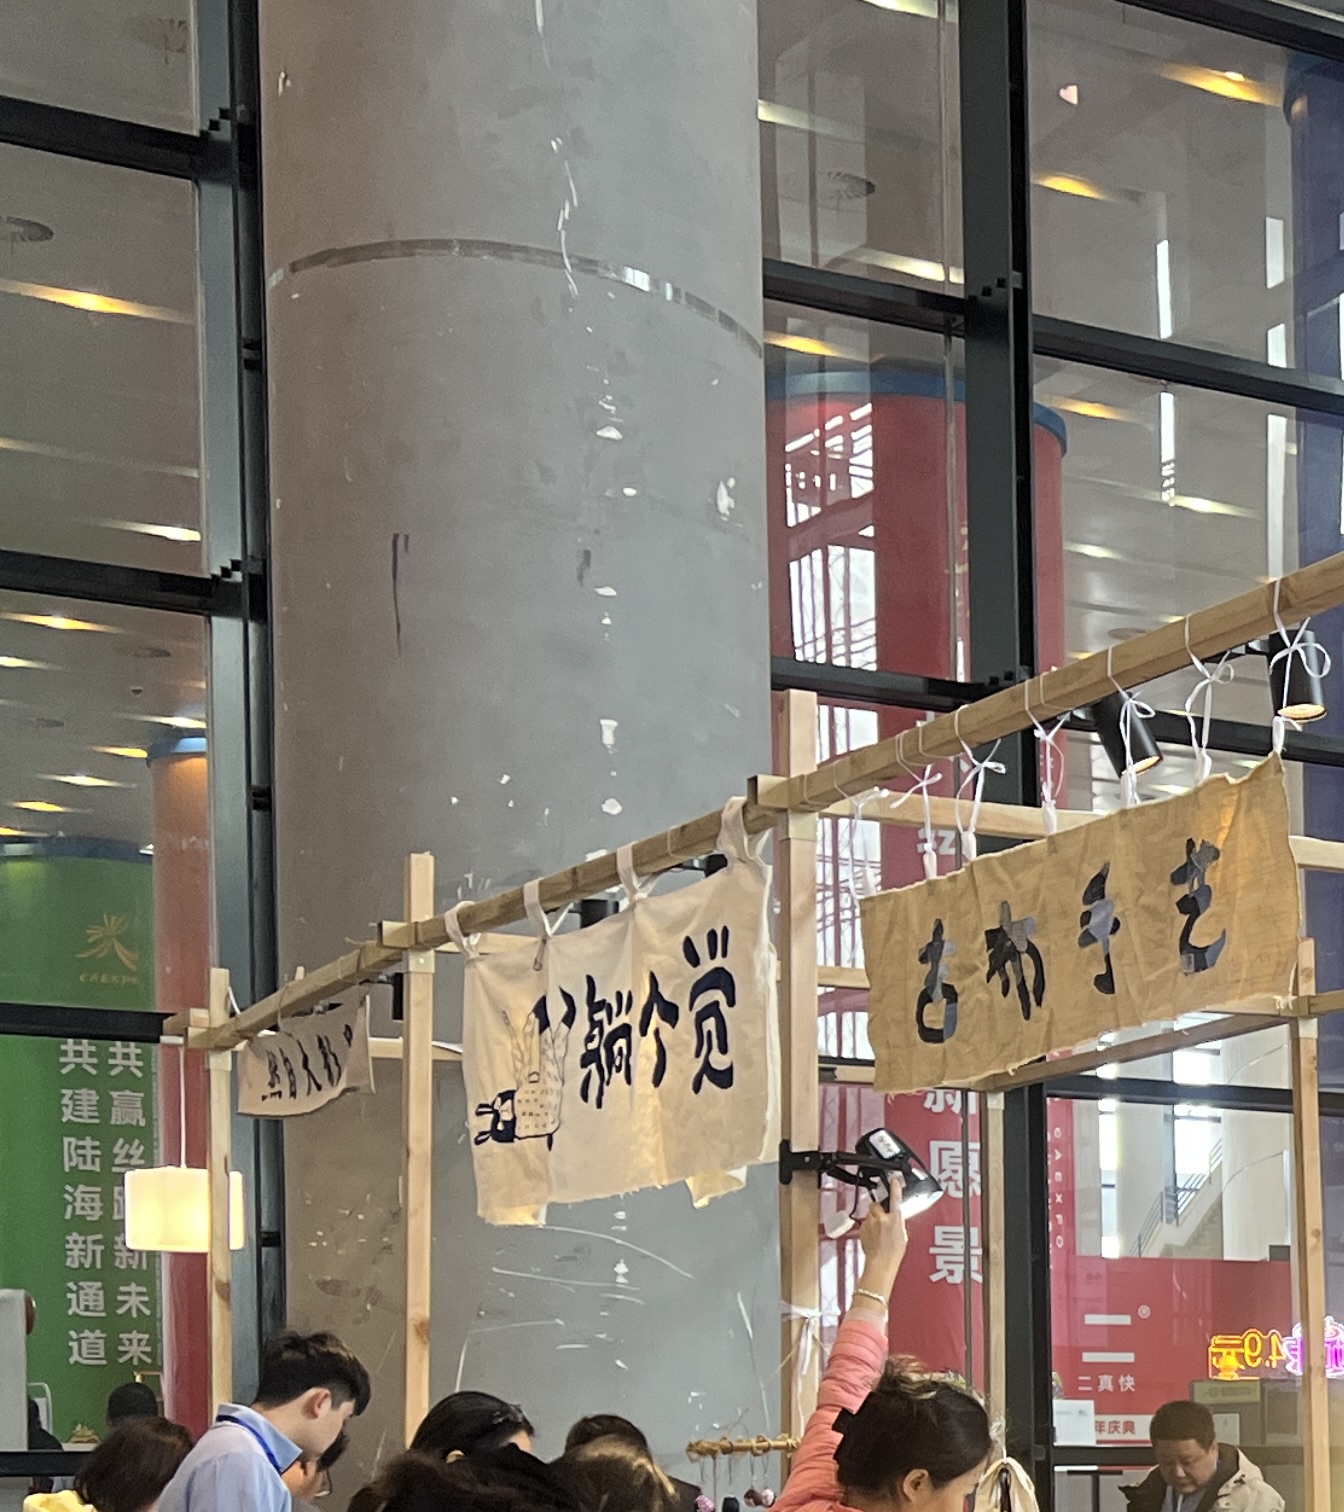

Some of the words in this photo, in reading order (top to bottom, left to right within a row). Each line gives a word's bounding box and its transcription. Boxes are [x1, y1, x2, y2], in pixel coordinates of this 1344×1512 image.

[58, 1038, 108, 1366] 共建陆海新通道
[107, 1041, 153, 1366] 共赢丝新未来
[1078, 1374, 1136, 1393] 二真快
